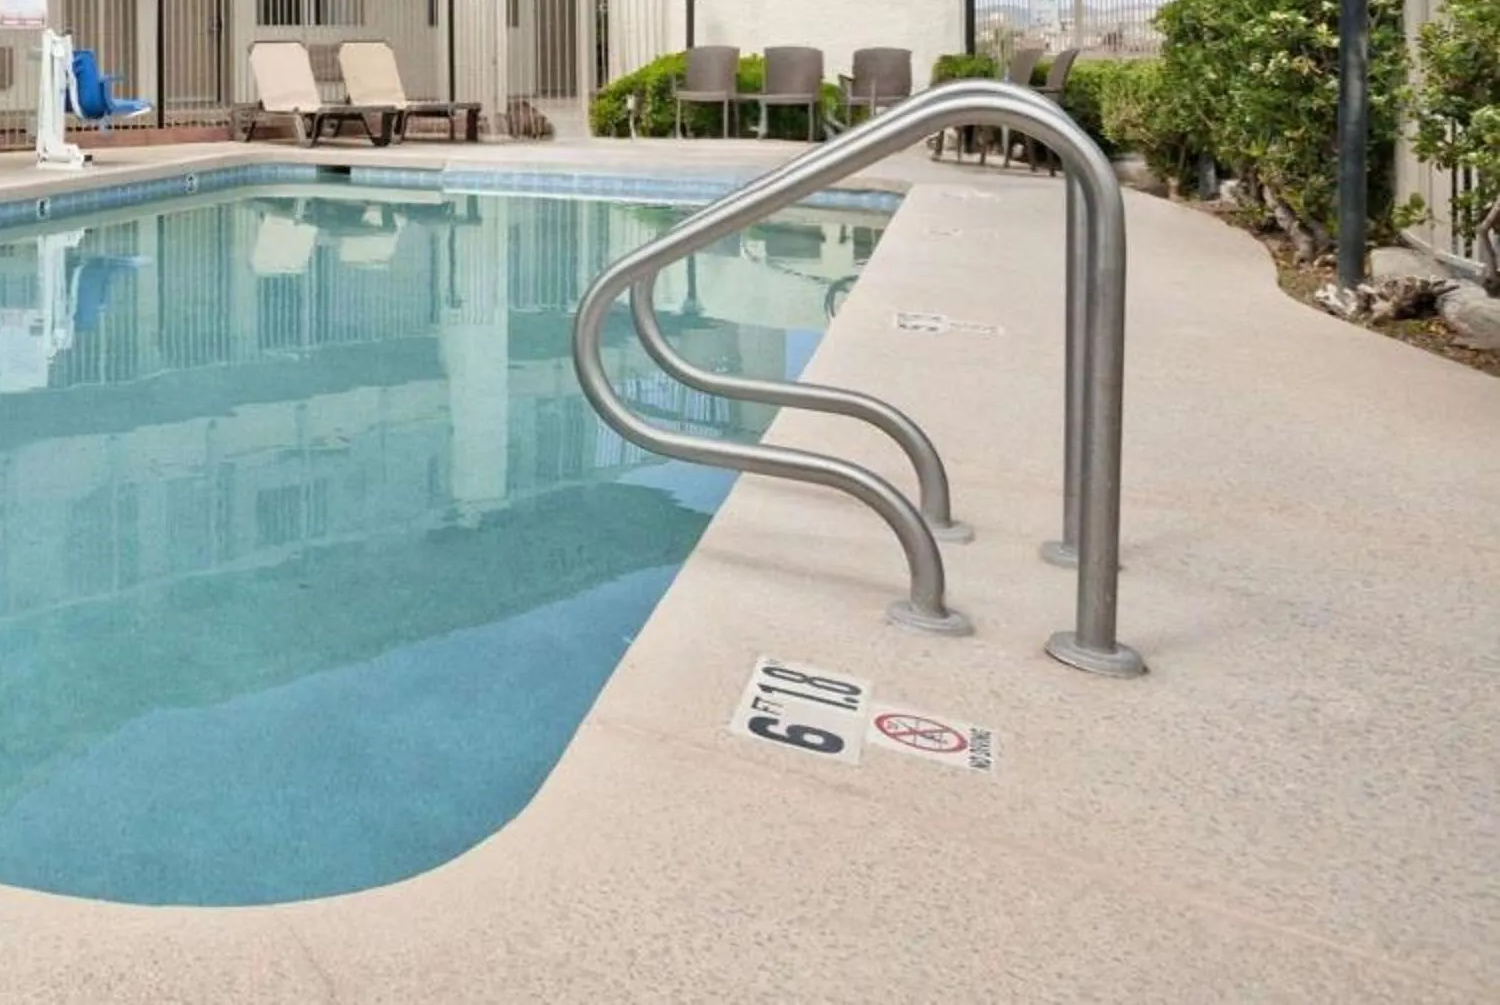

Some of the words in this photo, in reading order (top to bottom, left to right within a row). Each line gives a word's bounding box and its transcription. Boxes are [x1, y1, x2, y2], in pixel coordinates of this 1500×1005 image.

[751, 696, 785, 716] FT
[757, 666, 862, 711] 1.8
[748, 716, 845, 754] 6
